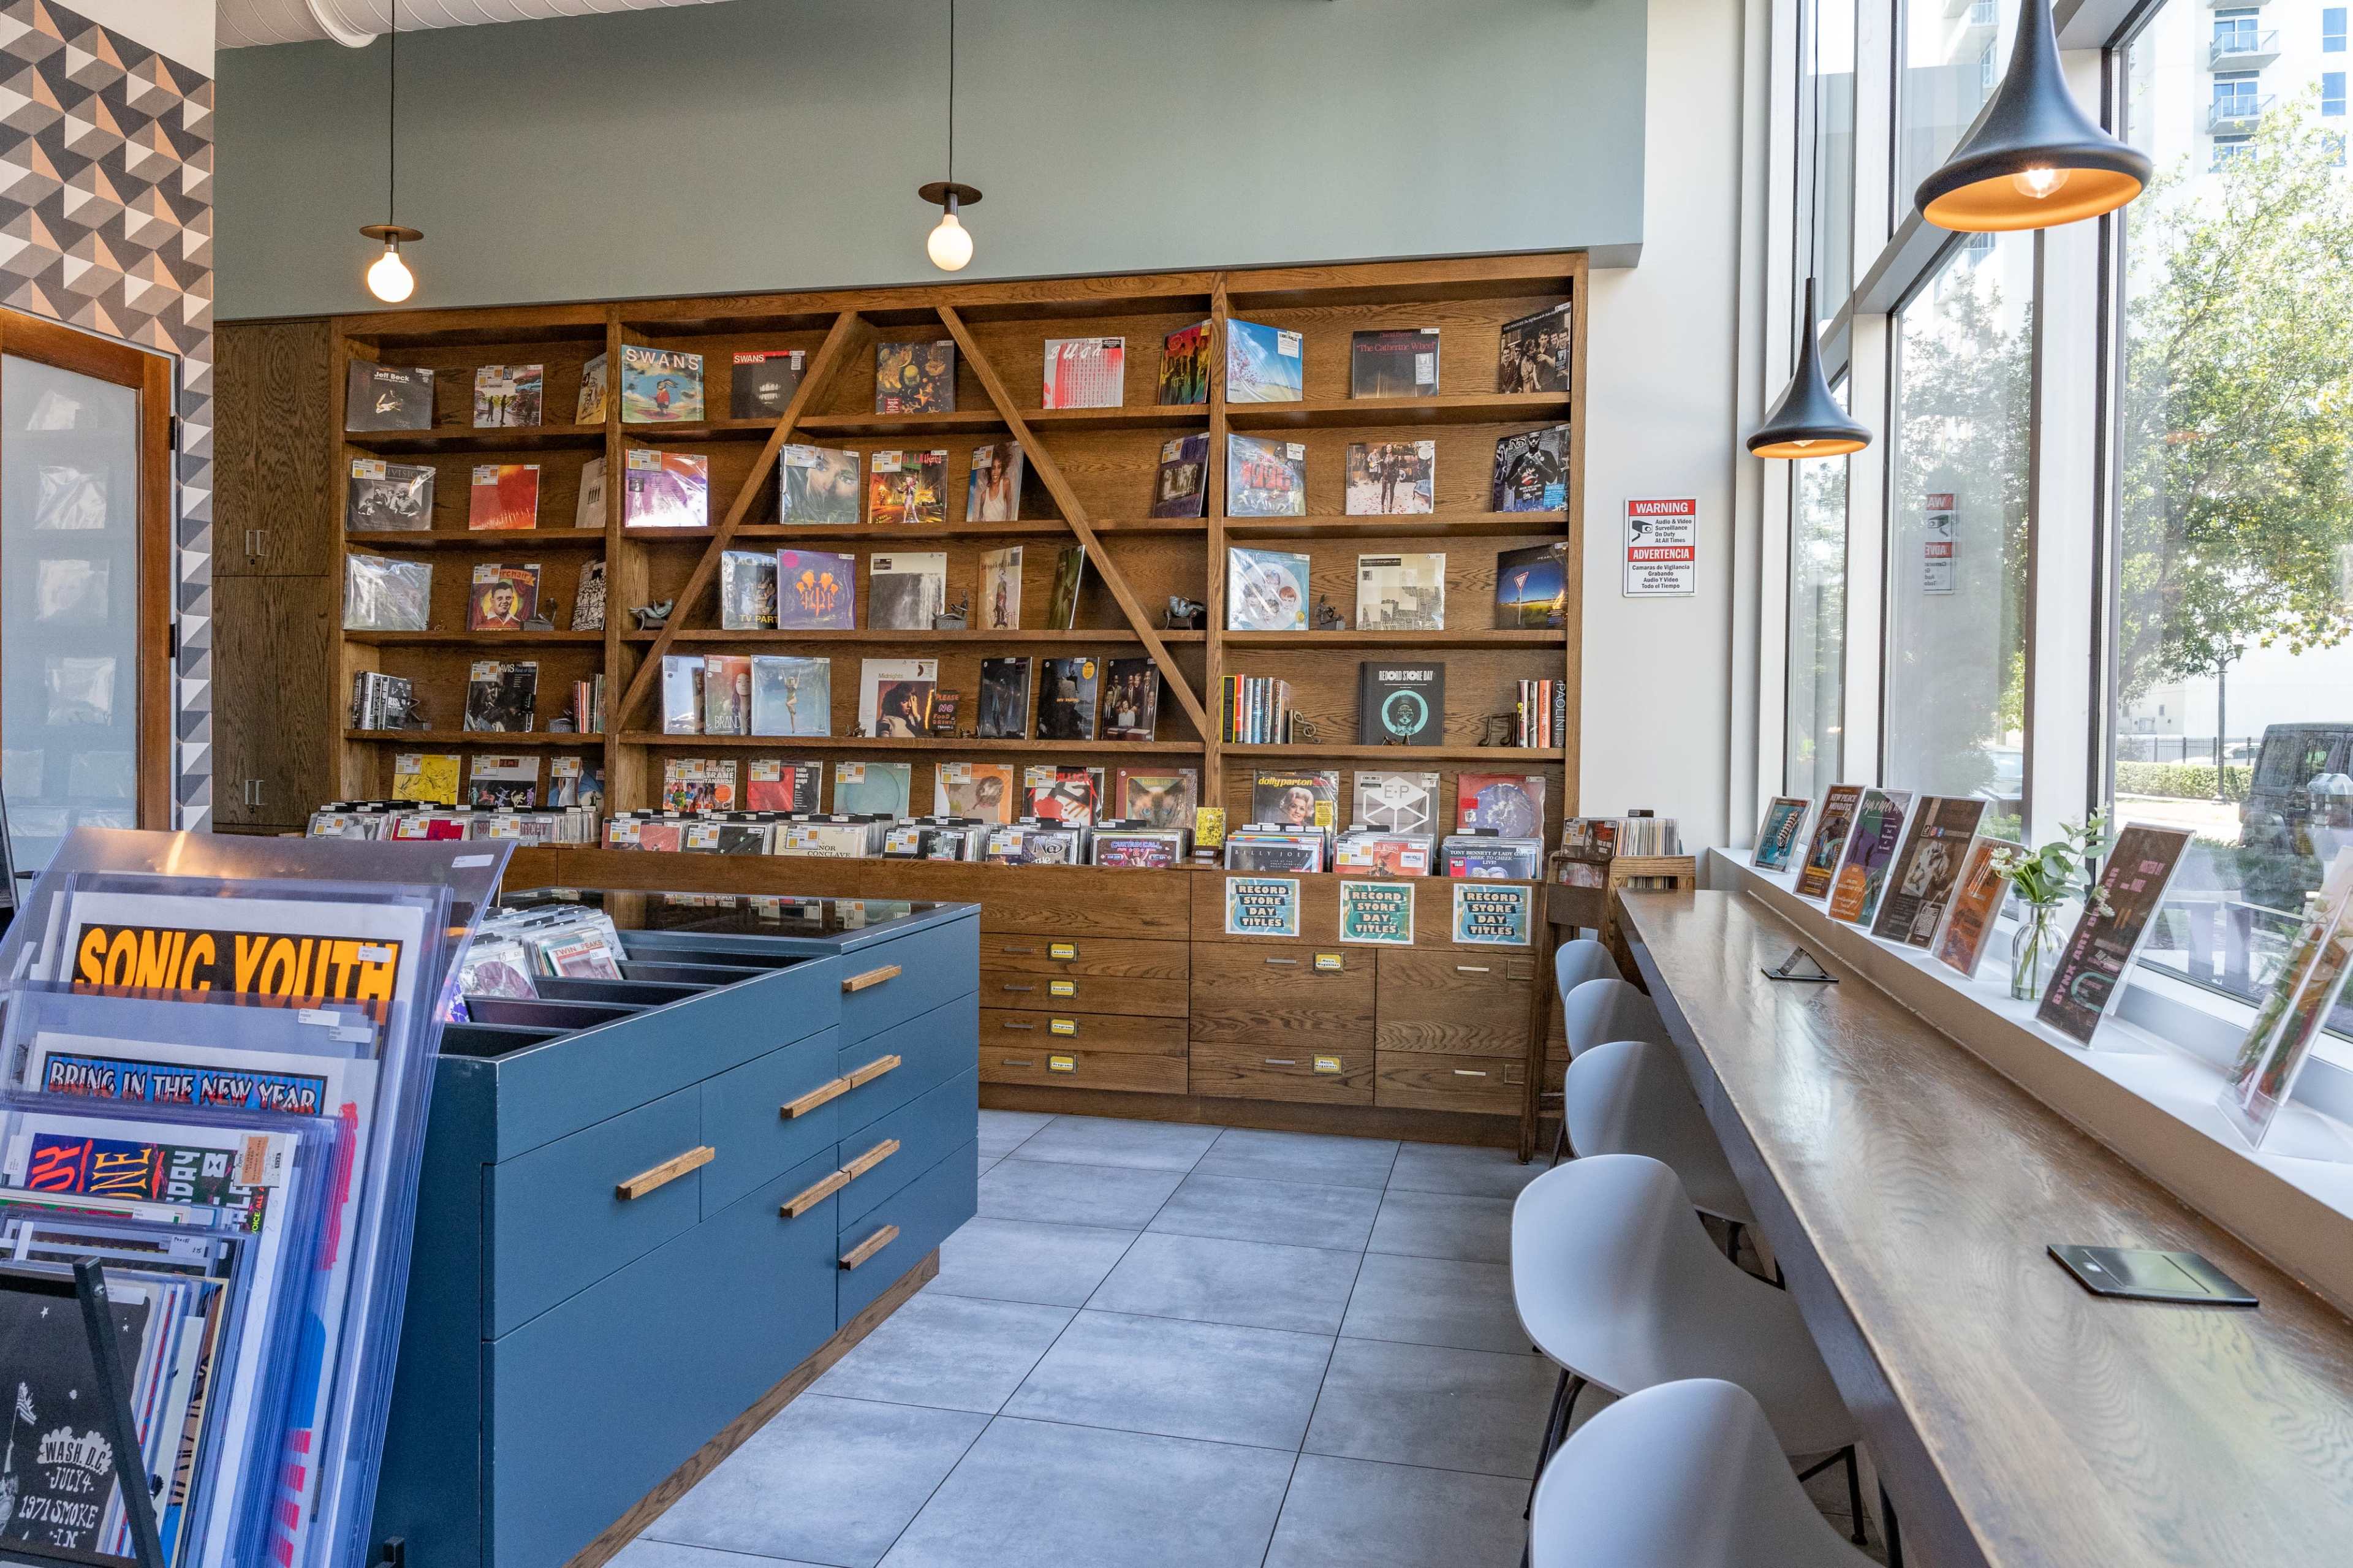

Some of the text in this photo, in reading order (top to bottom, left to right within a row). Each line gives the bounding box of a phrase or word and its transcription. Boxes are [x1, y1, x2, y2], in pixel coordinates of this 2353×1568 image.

[626, 348, 699, 371] SWANS
[734, 354, 765, 363] SWANS
[374, 371, 388, 379] Jeff
[390, 373, 410, 382] Beck
[1636, 502, 1688, 513] WARNING
[1633, 549, 1689, 559] ADVERTENCIA
[755, 615, 778, 623] PART
[1379, 670, 1433, 681] RECORD STORE DAY
[938, 703, 954, 713] NO
[1556, 683, 1566, 731] PAOLINI
[1134, 847, 1140, 857] 2
[1243, 896, 1281, 905] STORE
[1352, 892, 1401, 901] RECORD
[1467, 893, 1517, 901] RECORD
[1357, 903, 1396, 912] STORE
[1471, 904, 1512, 913] STORE
[1243, 918, 1282, 926] TITLES
[1362, 914, 1390, 922] DAY
[1477, 915, 1504, 923] DAY
[1355, 925, 1396, 933] TITLES
[1470, 926, 1512, 935] TITLES
[555, 939, 604, 956] TWIN PEAKS
[2052, 931, 2091, 1006] BYNX ART
[74, 927, 398, 1025] SONIC YOUTH
[50, 1061, 317, 1115] BRING IN THE NEW YEAR
[45, 1441, 83, 1464] WASH.
[50, 1467, 84, 1493] JULY
[18, 1495, 99, 1529] 1971 SMOKE
